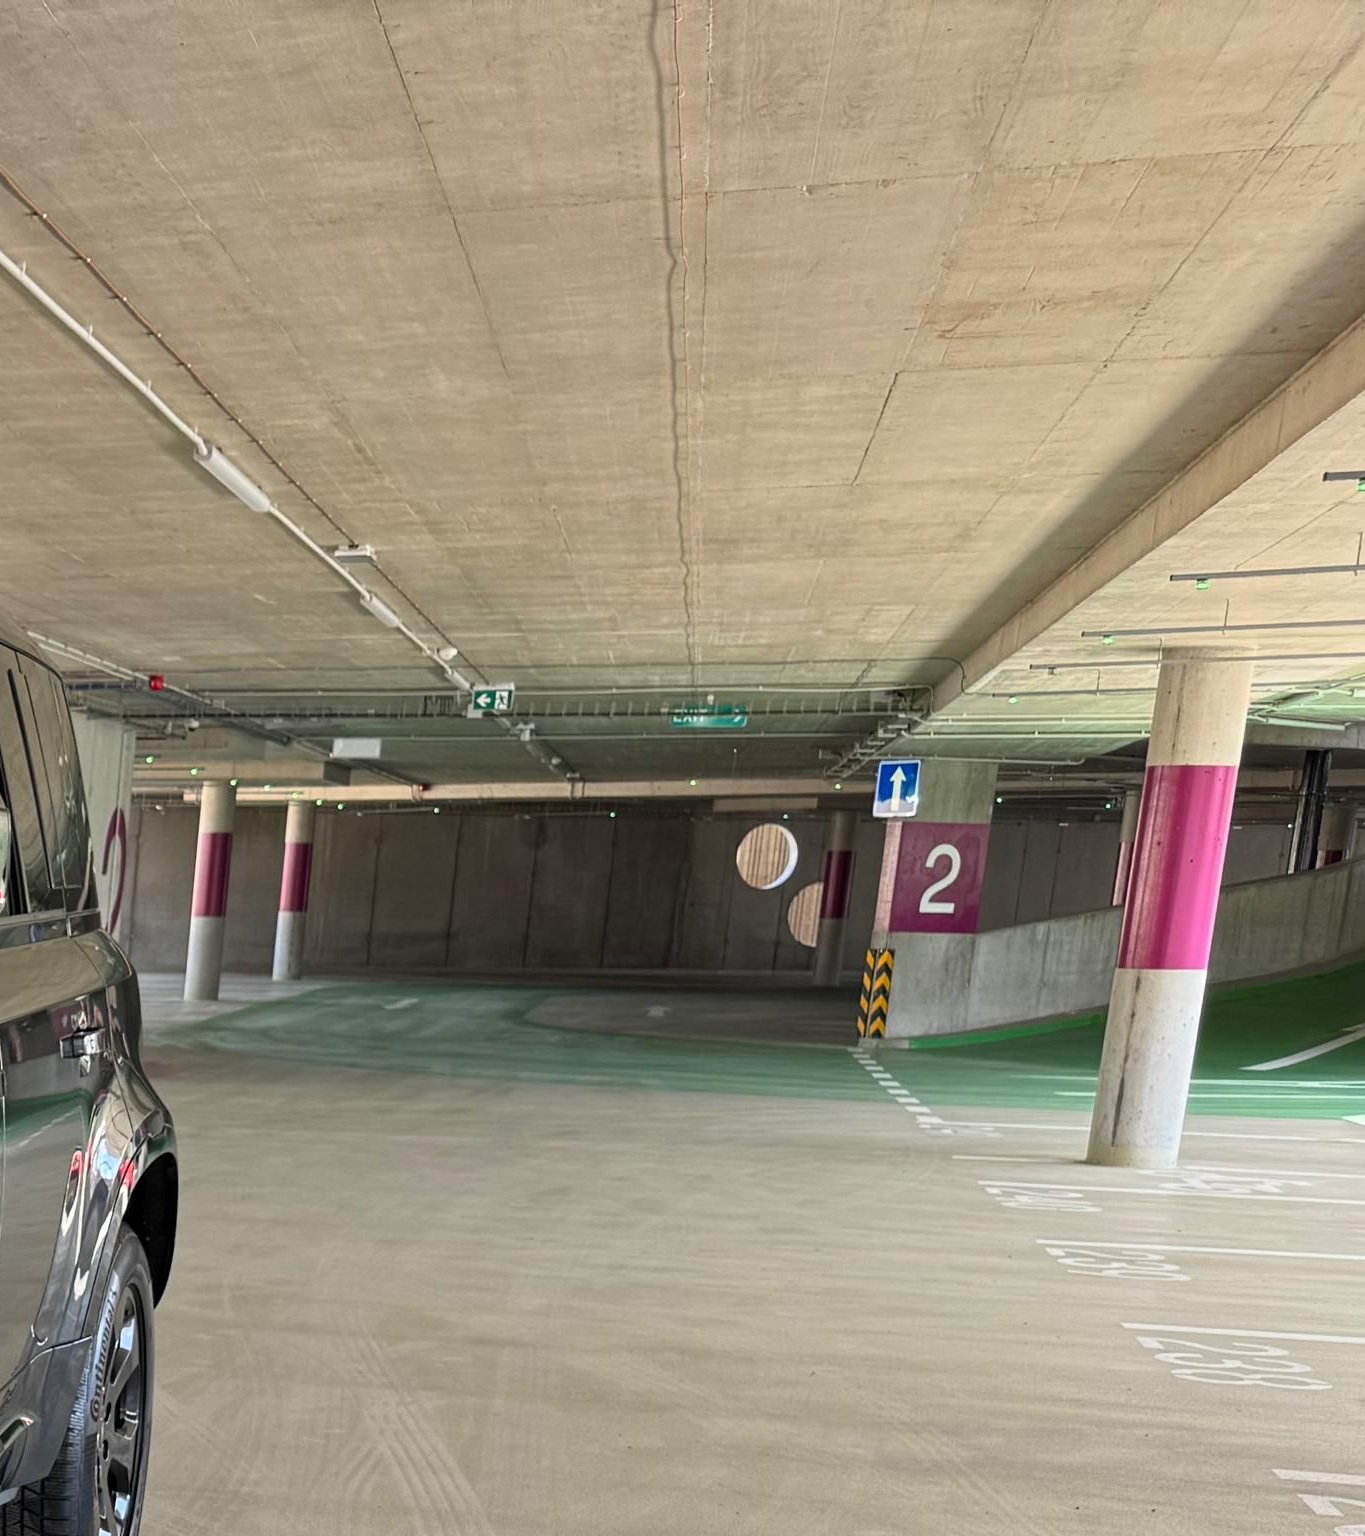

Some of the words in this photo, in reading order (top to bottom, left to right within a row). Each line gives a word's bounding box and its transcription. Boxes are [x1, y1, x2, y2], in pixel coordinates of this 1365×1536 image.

[918, 843, 962, 914] 2
[1045, 1247, 1193, 1282] 239
[1135, 1336, 1333, 1391] 238
